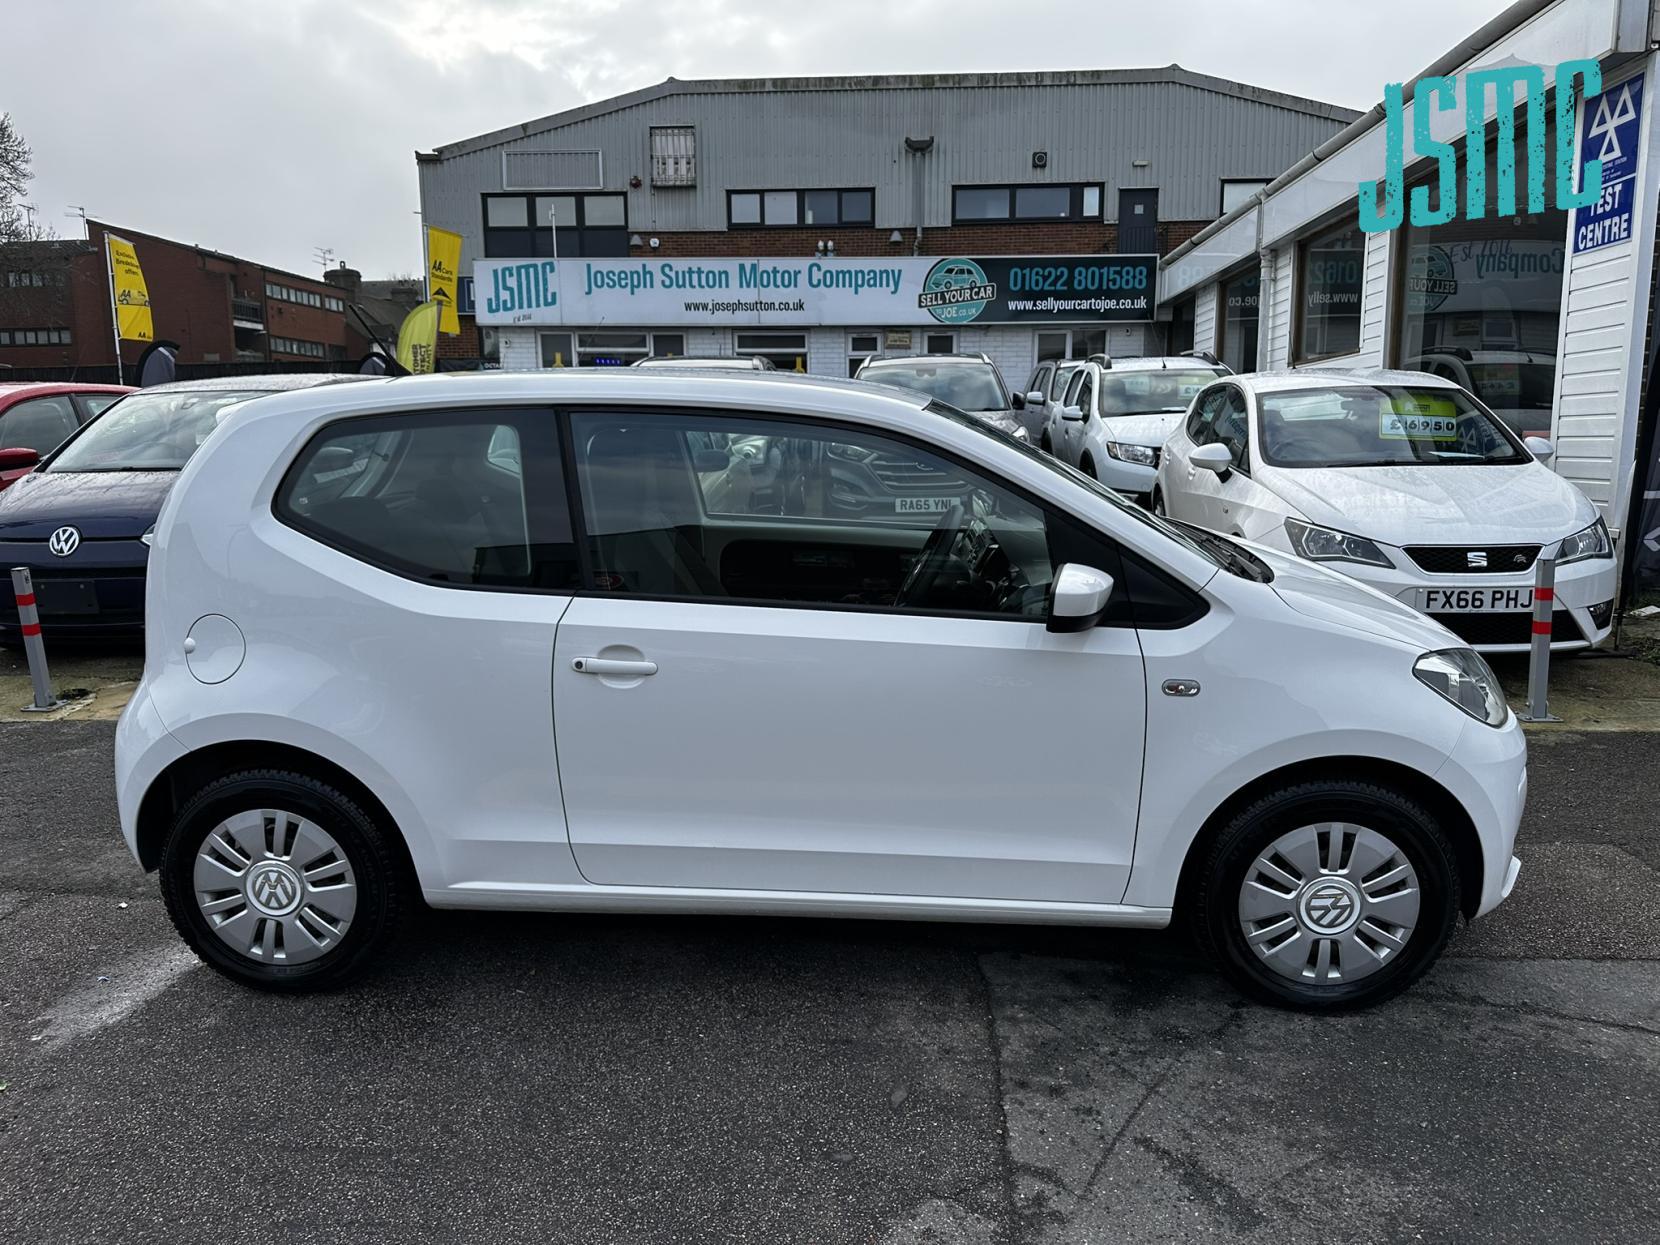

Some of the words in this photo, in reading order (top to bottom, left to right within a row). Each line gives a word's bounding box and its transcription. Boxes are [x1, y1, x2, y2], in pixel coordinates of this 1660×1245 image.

[1578, 212, 1629, 250] CENTRE
[432, 259, 442, 273] AA
[487, 261, 557, 314] JSMC
[585, 263, 654, 295] Joseph
[660, 263, 730, 289] Sutton
[738, 263, 802, 289] Motor
[808, 262, 902, 295] Company
[1009, 267, 1068, 291] 01622
[1074, 266, 1147, 290] 801588
[120, 289, 131, 298] AA
[920, 294, 943, 307] SELL
[944, 290, 971, 303] YOUR
[971, 286, 993, 300] CAR
[684, 299, 805, 315] www.josephsutton.co.uk
[1007, 295, 1147, 313] www.sellyourcartojoe.co.uk
[900, 500, 930, 511] RA65
[1426, 590, 1484, 609] FX66
[1490, 589, 1533, 609] PHJ
